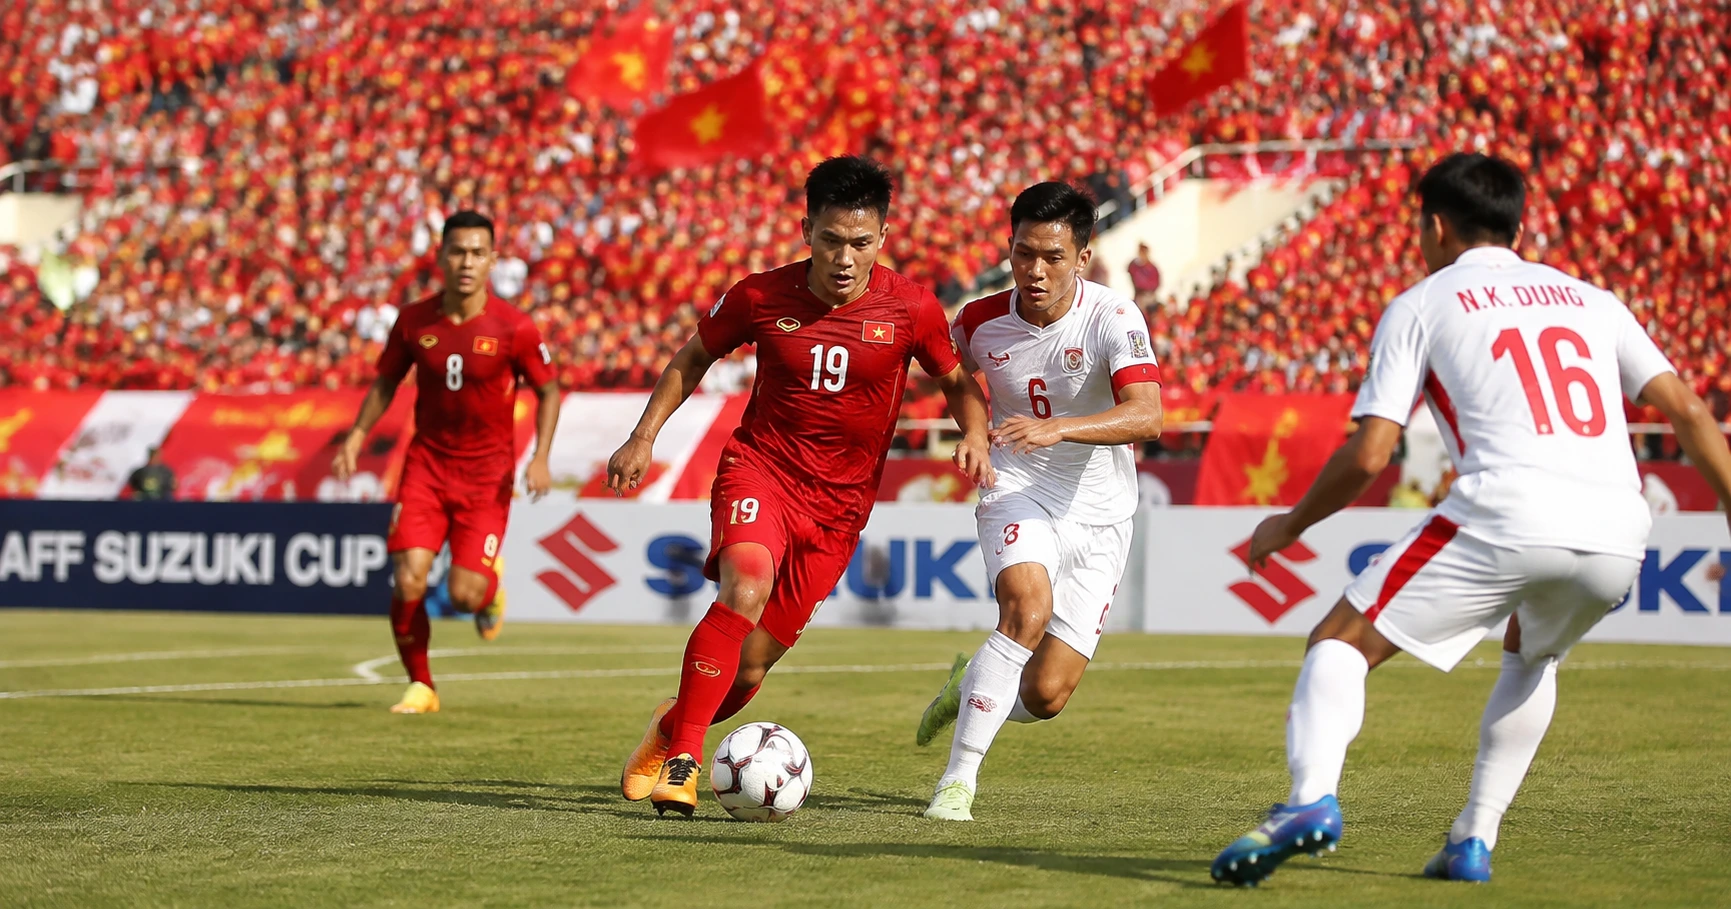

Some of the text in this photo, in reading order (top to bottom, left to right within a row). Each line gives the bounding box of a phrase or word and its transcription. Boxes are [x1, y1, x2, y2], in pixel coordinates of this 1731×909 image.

[446, 353, 464, 391] 8
[810, 344, 849, 392] 19
[1491, 326, 1606, 437] 16
[1028, 377, 1052, 420] 6
[730, 497, 760, 525] 19
[0, 530, 86, 582] AFF
[93, 530, 275, 585] SUZUKI
[283, 532, 388, 587] CUP
